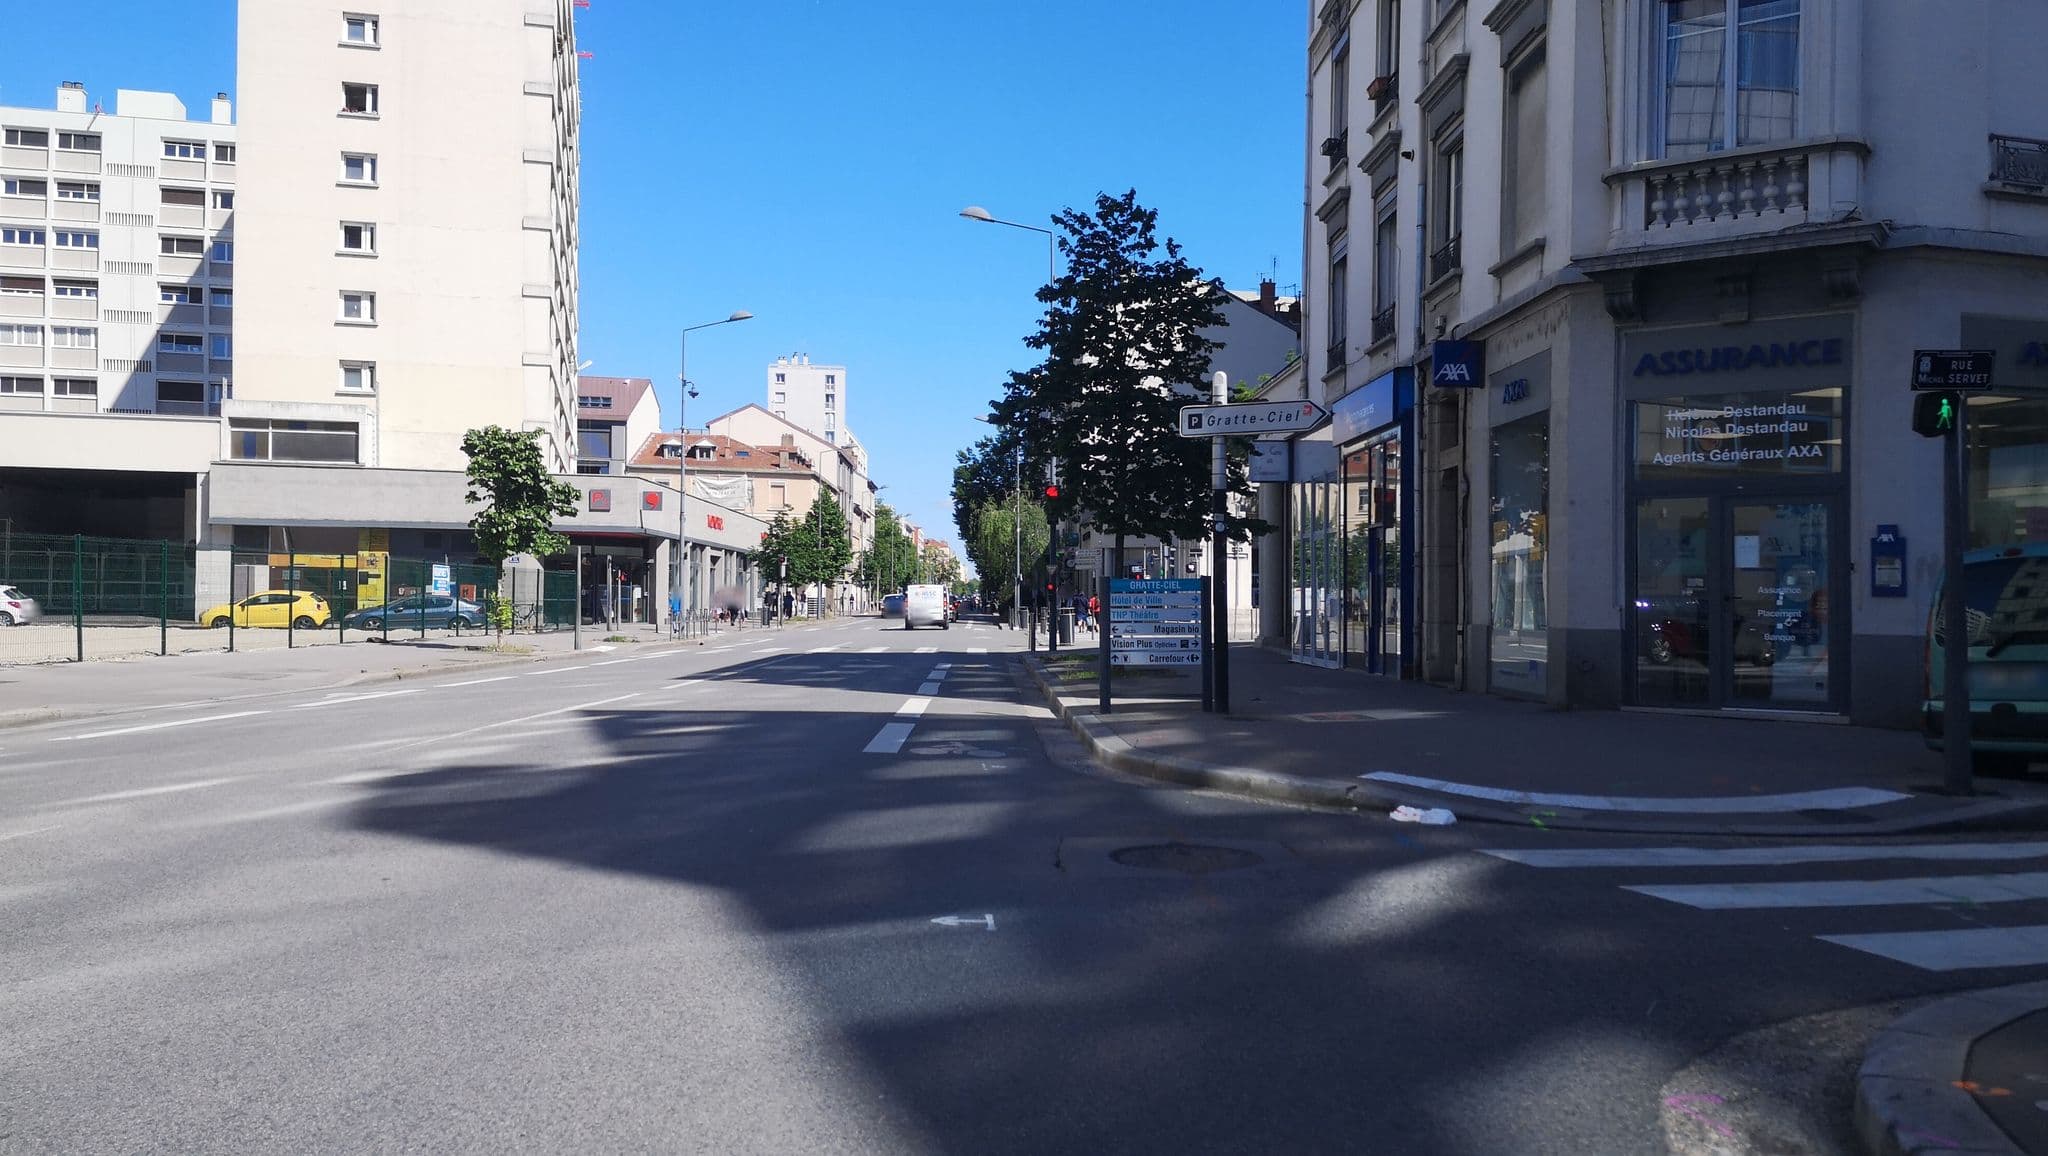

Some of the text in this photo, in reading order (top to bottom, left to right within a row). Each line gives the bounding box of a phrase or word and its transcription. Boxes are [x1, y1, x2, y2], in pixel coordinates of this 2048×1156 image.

[1633, 337, 1843, 377] ASSURANCE
[1951, 360, 1974, 370] RUE
[1434, 363, 1471, 381] AXA
[1948, 373, 1989, 384] SERVET
[1723, 402, 1806, 418] Destandau
[1191, 409, 1300, 427] P Gratte-Ciel
[1666, 420, 1808, 439] Nicolas Destandau
[1652, 444, 1823, 466] Agents Généraux AXA
[1877, 533, 1895, 543] AXA
[1129, 580, 1181, 590] GRATTE-CIEL
[1757, 586, 1801, 594] Assurance
[1111, 594, 1163, 604] Hôtel de Ville
[1111, 611, 1128, 619] TNP
[1757, 609, 1802, 618] Placement
[1153, 625, 1200, 635] Magasin bio
[1764, 633, 1796, 643] Banque
[1111, 639, 1135, 648] Vision
[1136, 639, 1153, 648] Plus
[1149, 653, 1185, 663] Carrefour
